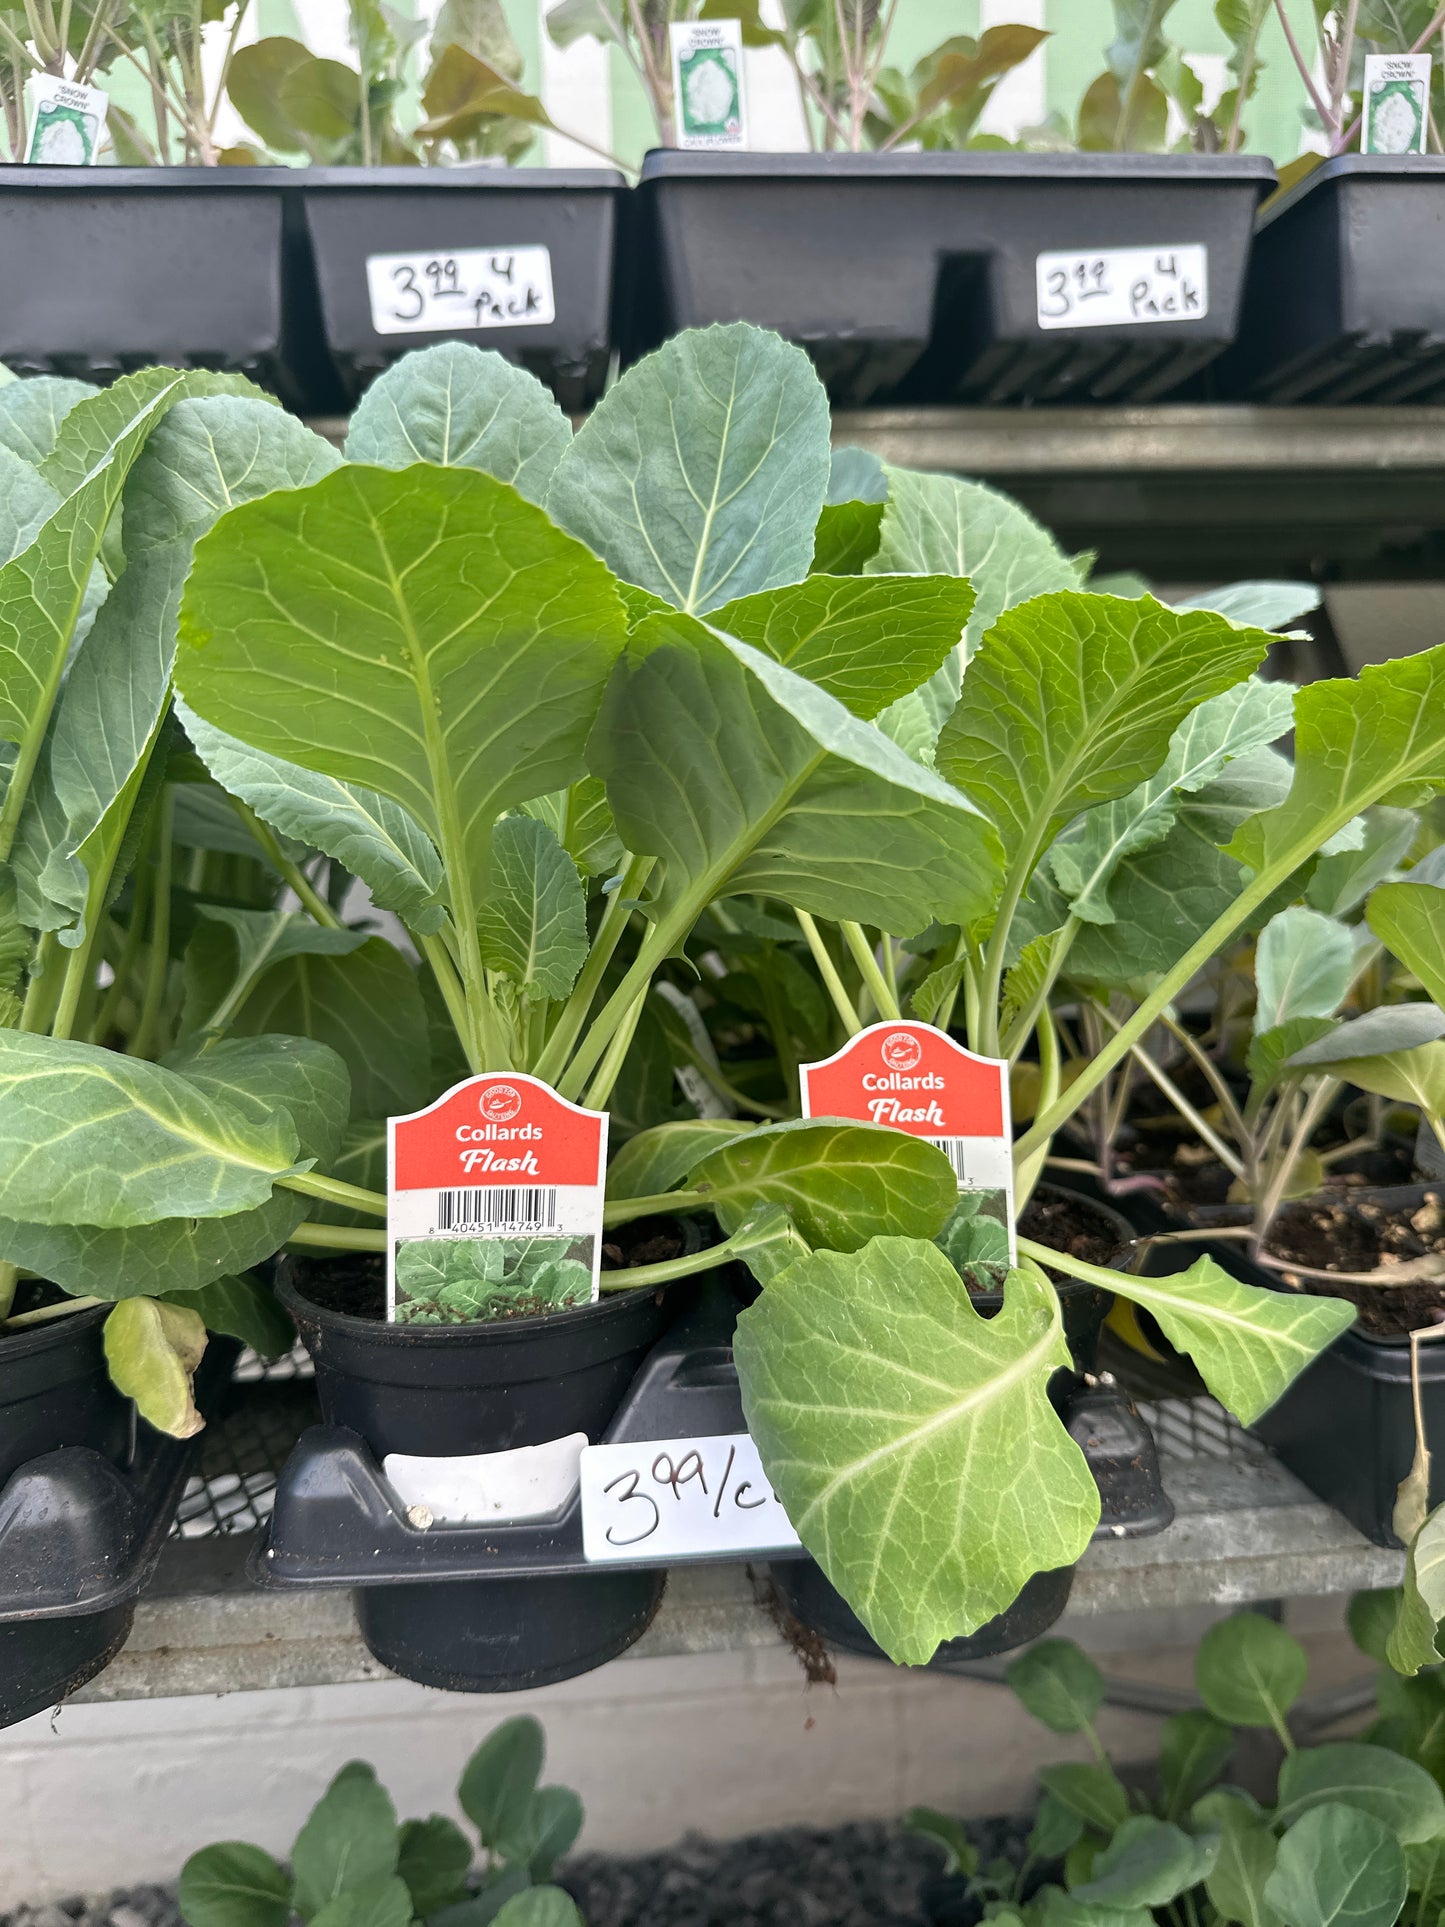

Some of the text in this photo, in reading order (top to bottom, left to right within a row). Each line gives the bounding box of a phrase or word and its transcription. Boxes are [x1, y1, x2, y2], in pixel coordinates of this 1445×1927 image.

[491, 256, 513, 282] 4
[1157, 255, 1177, 279] 4
[862, 1072, 945, 1091] Collards
[867, 1098, 946, 1127] Flash
[455, 1123, 543, 1142] Collards
[459, 1148, 541, 1176] Flash
[968, 1177, 974, 1186] 3
[452, 1222, 493, 1233] 40451
[501, 1221, 541, 1232] 14749
